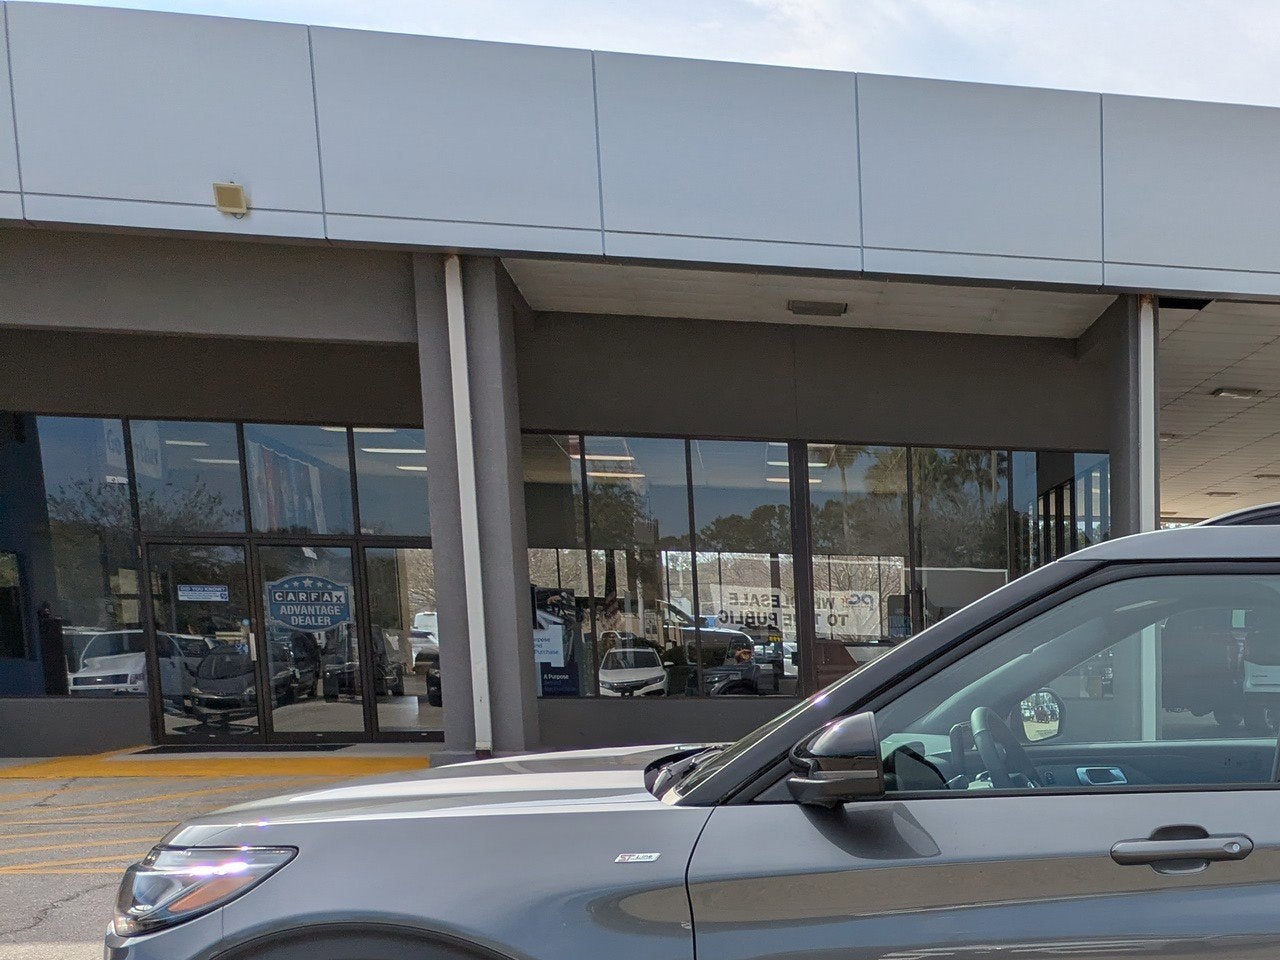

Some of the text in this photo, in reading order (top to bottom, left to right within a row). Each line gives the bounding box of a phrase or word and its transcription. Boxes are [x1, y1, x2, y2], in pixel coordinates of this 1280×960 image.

[274, 592, 344, 603] CARFAX
[280, 605, 341, 615] ADVANTAGE
[291, 616, 331, 625] DEALER
